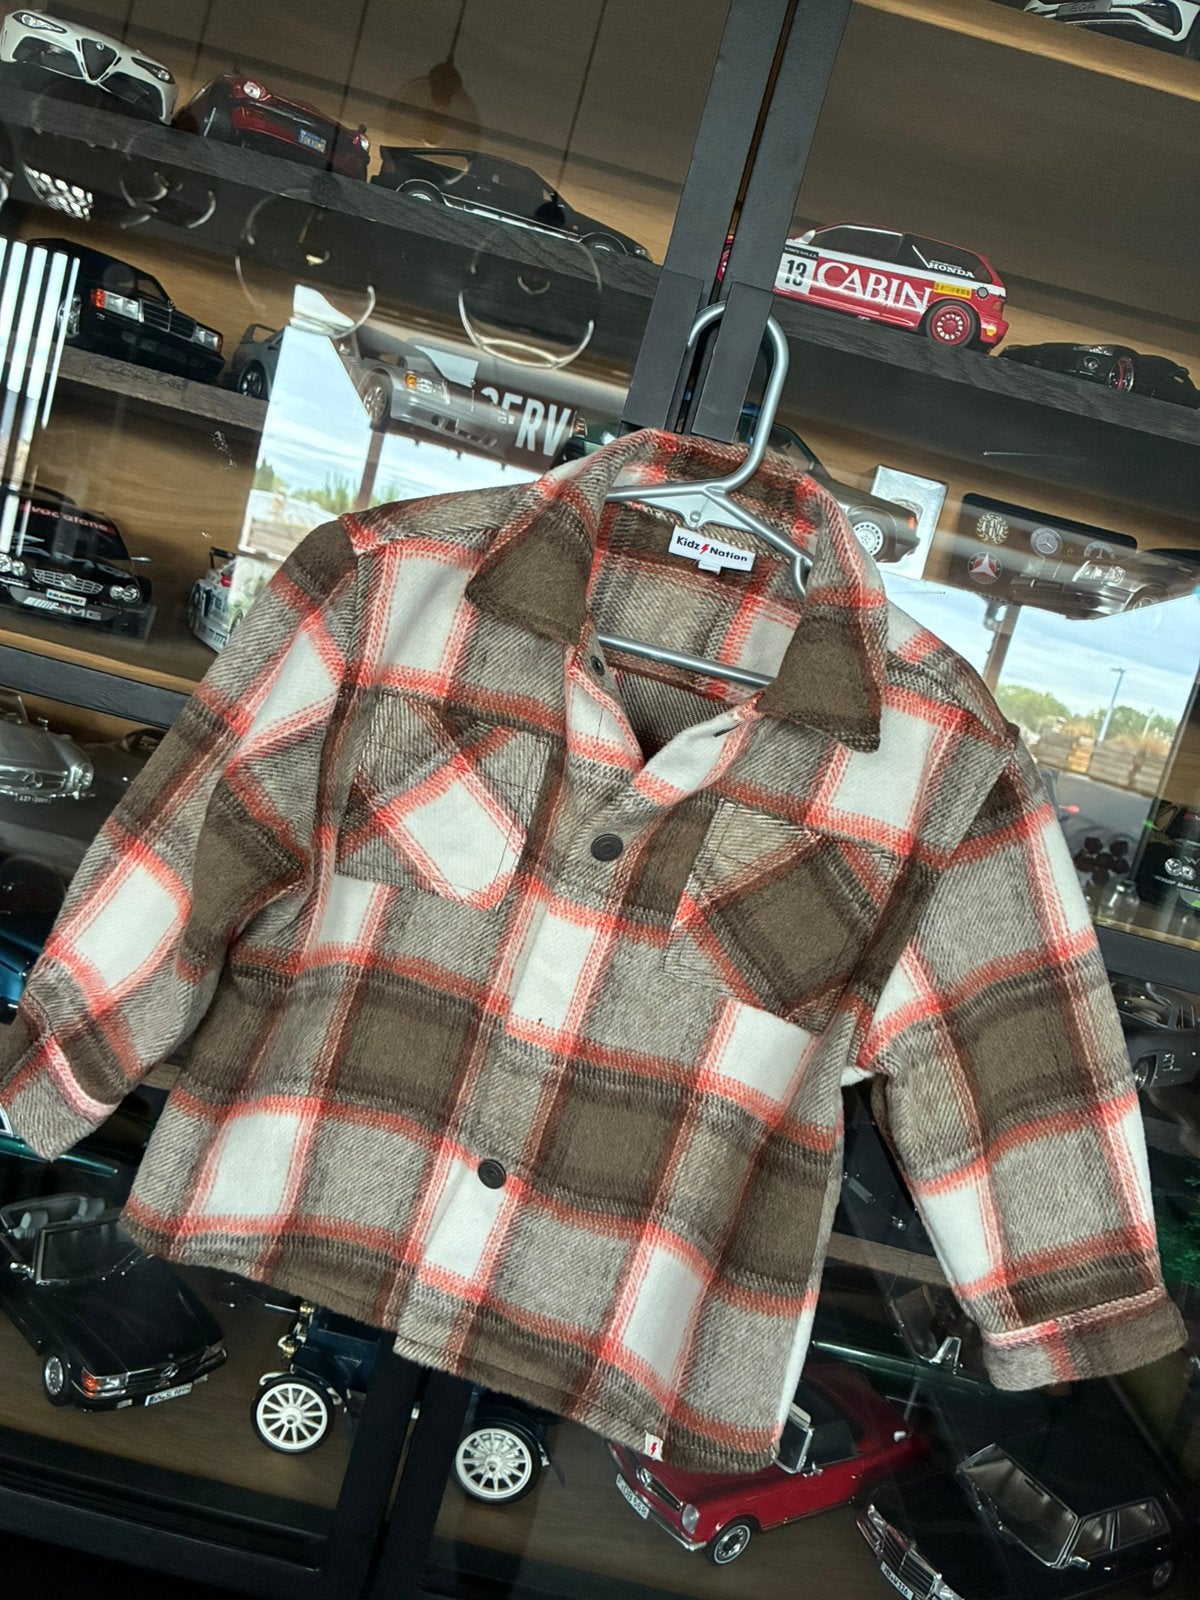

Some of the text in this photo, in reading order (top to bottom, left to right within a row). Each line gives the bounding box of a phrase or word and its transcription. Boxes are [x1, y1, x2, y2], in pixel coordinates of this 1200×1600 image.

[784, 259, 808, 286] 13
[929, 262, 975, 278] HONDA
[817, 262, 934, 314] CABIN
[676, 535, 748, 562] Kidz Nation
[48, 601, 102, 620] AMG
